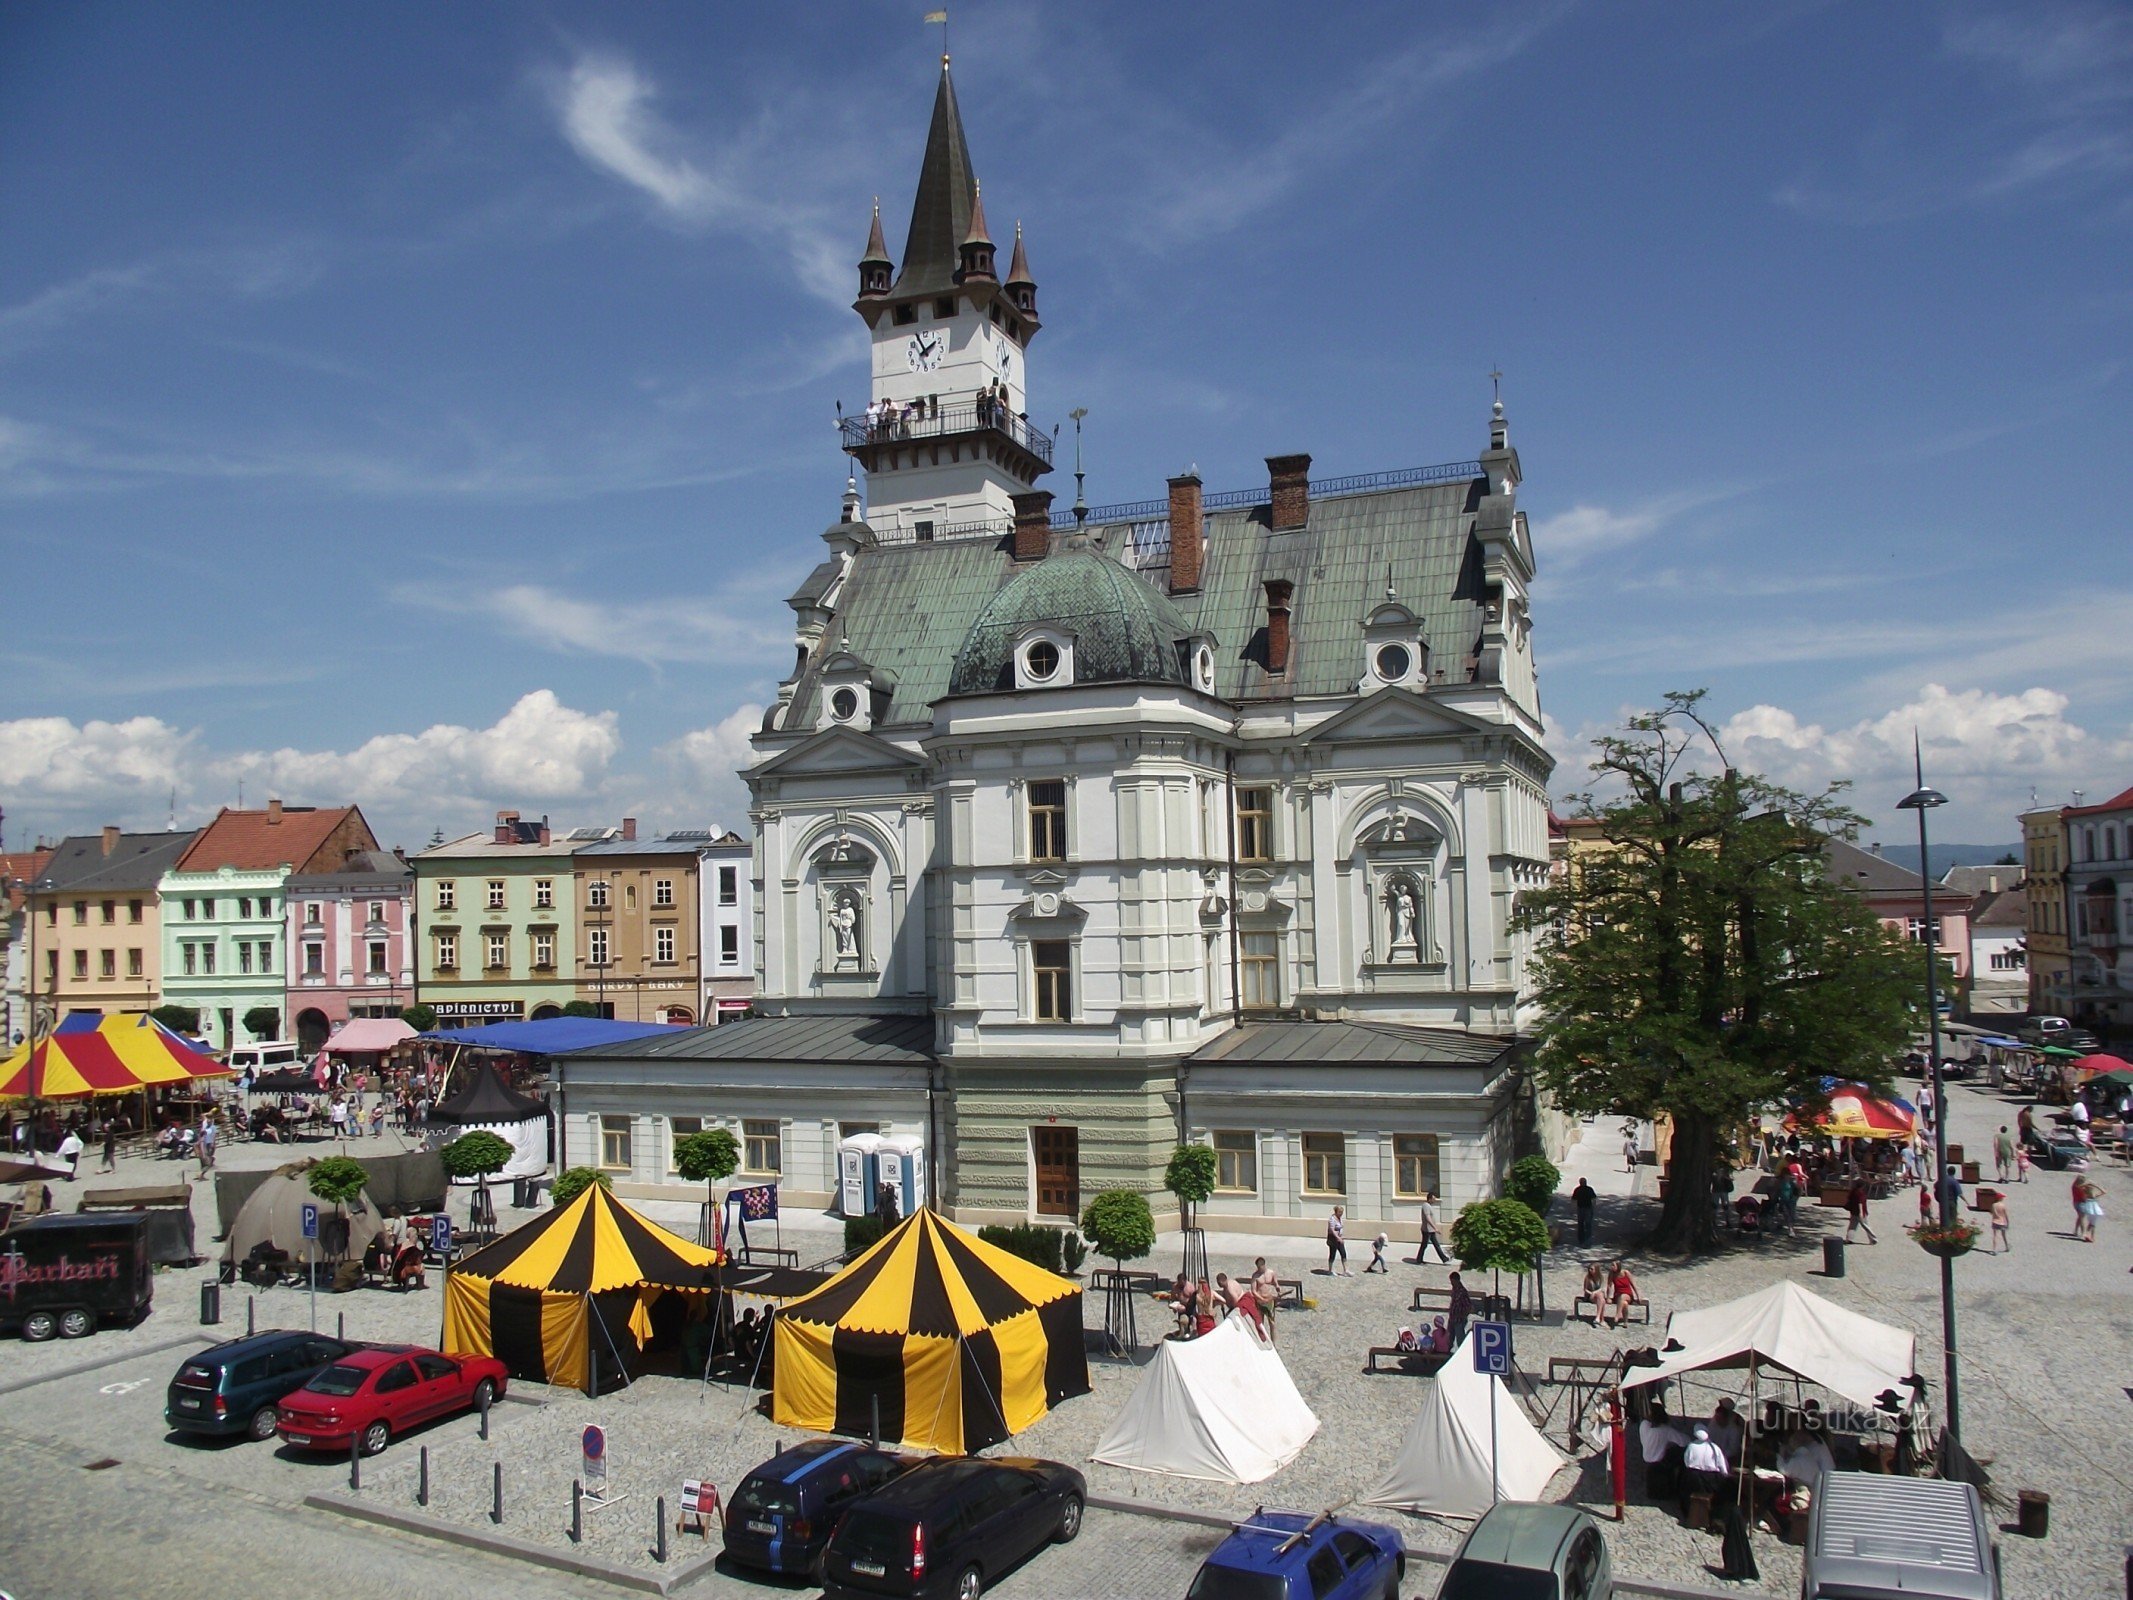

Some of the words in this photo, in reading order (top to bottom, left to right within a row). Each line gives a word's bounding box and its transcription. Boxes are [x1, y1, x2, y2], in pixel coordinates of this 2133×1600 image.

[305, 1209, 315, 1227] P
[436, 1219, 447, 1239] P
[1481, 1328, 1501, 1358] P
